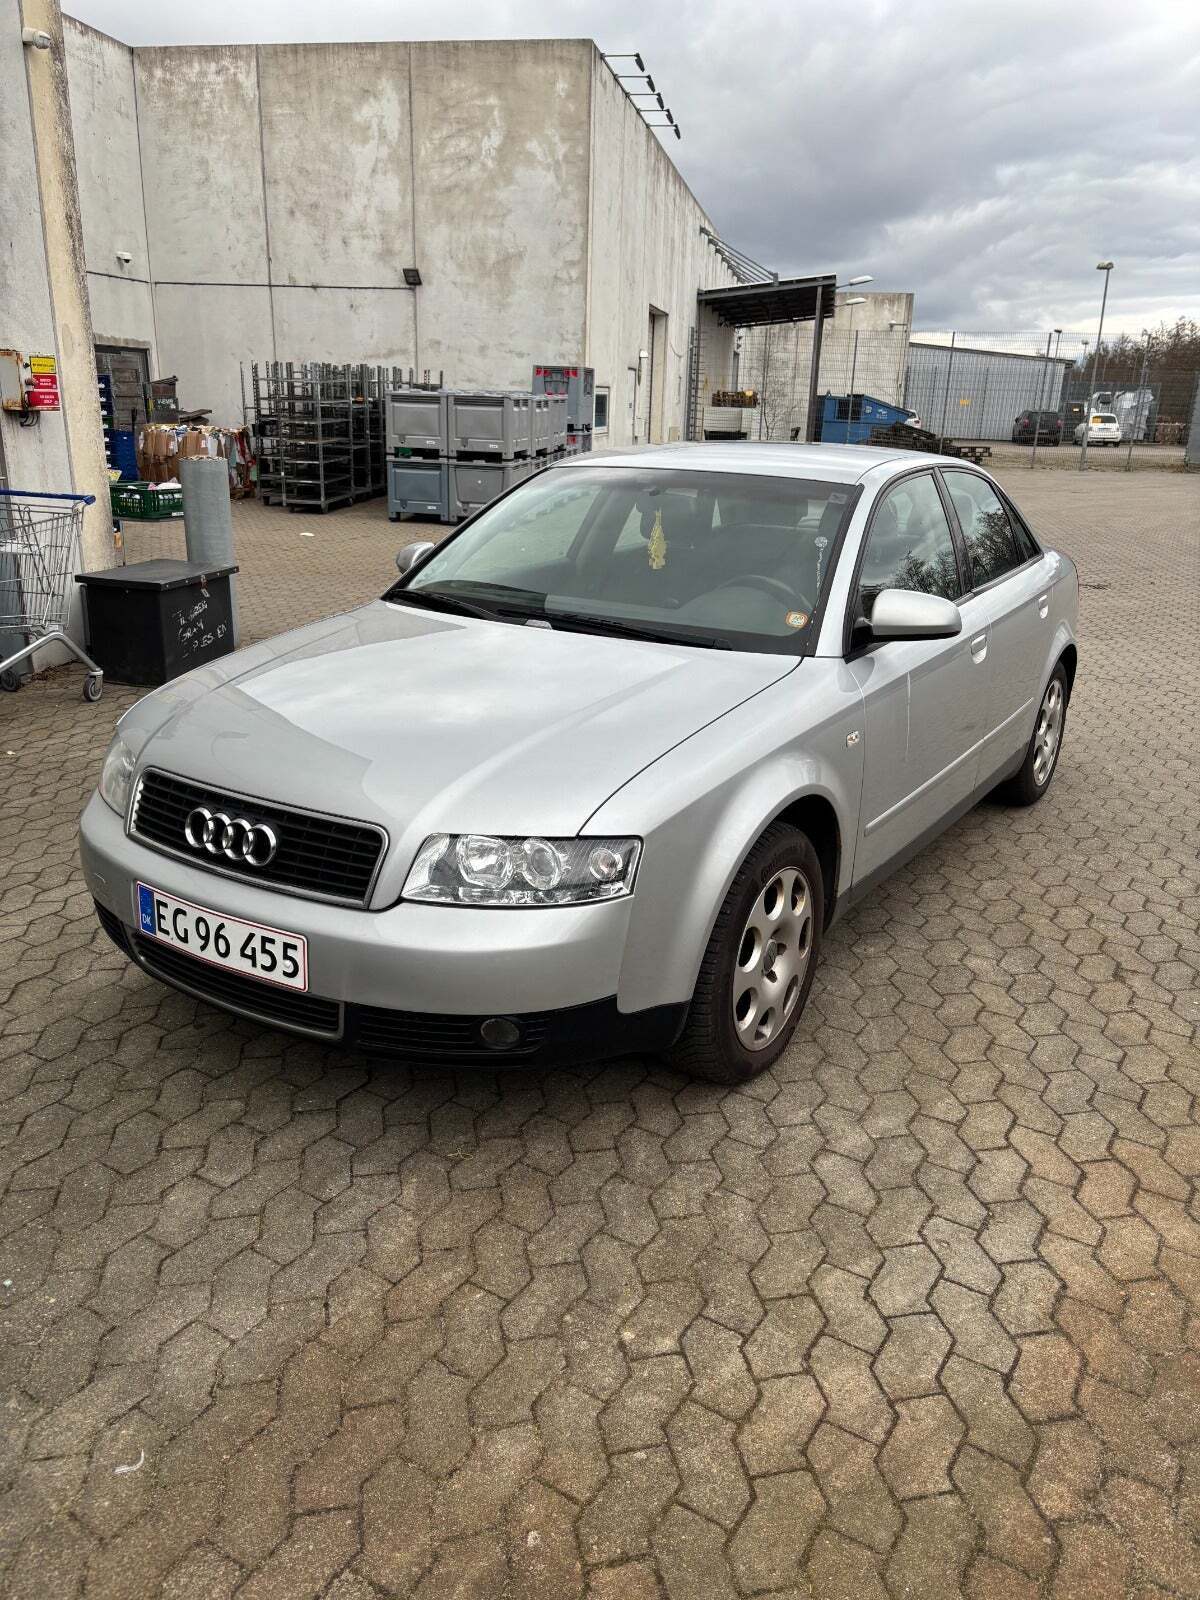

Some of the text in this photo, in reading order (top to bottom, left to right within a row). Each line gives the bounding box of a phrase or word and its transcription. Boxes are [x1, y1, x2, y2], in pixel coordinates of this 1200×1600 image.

[142, 913, 151, 926] DK
[155, 898, 299, 978] EG 96 455
